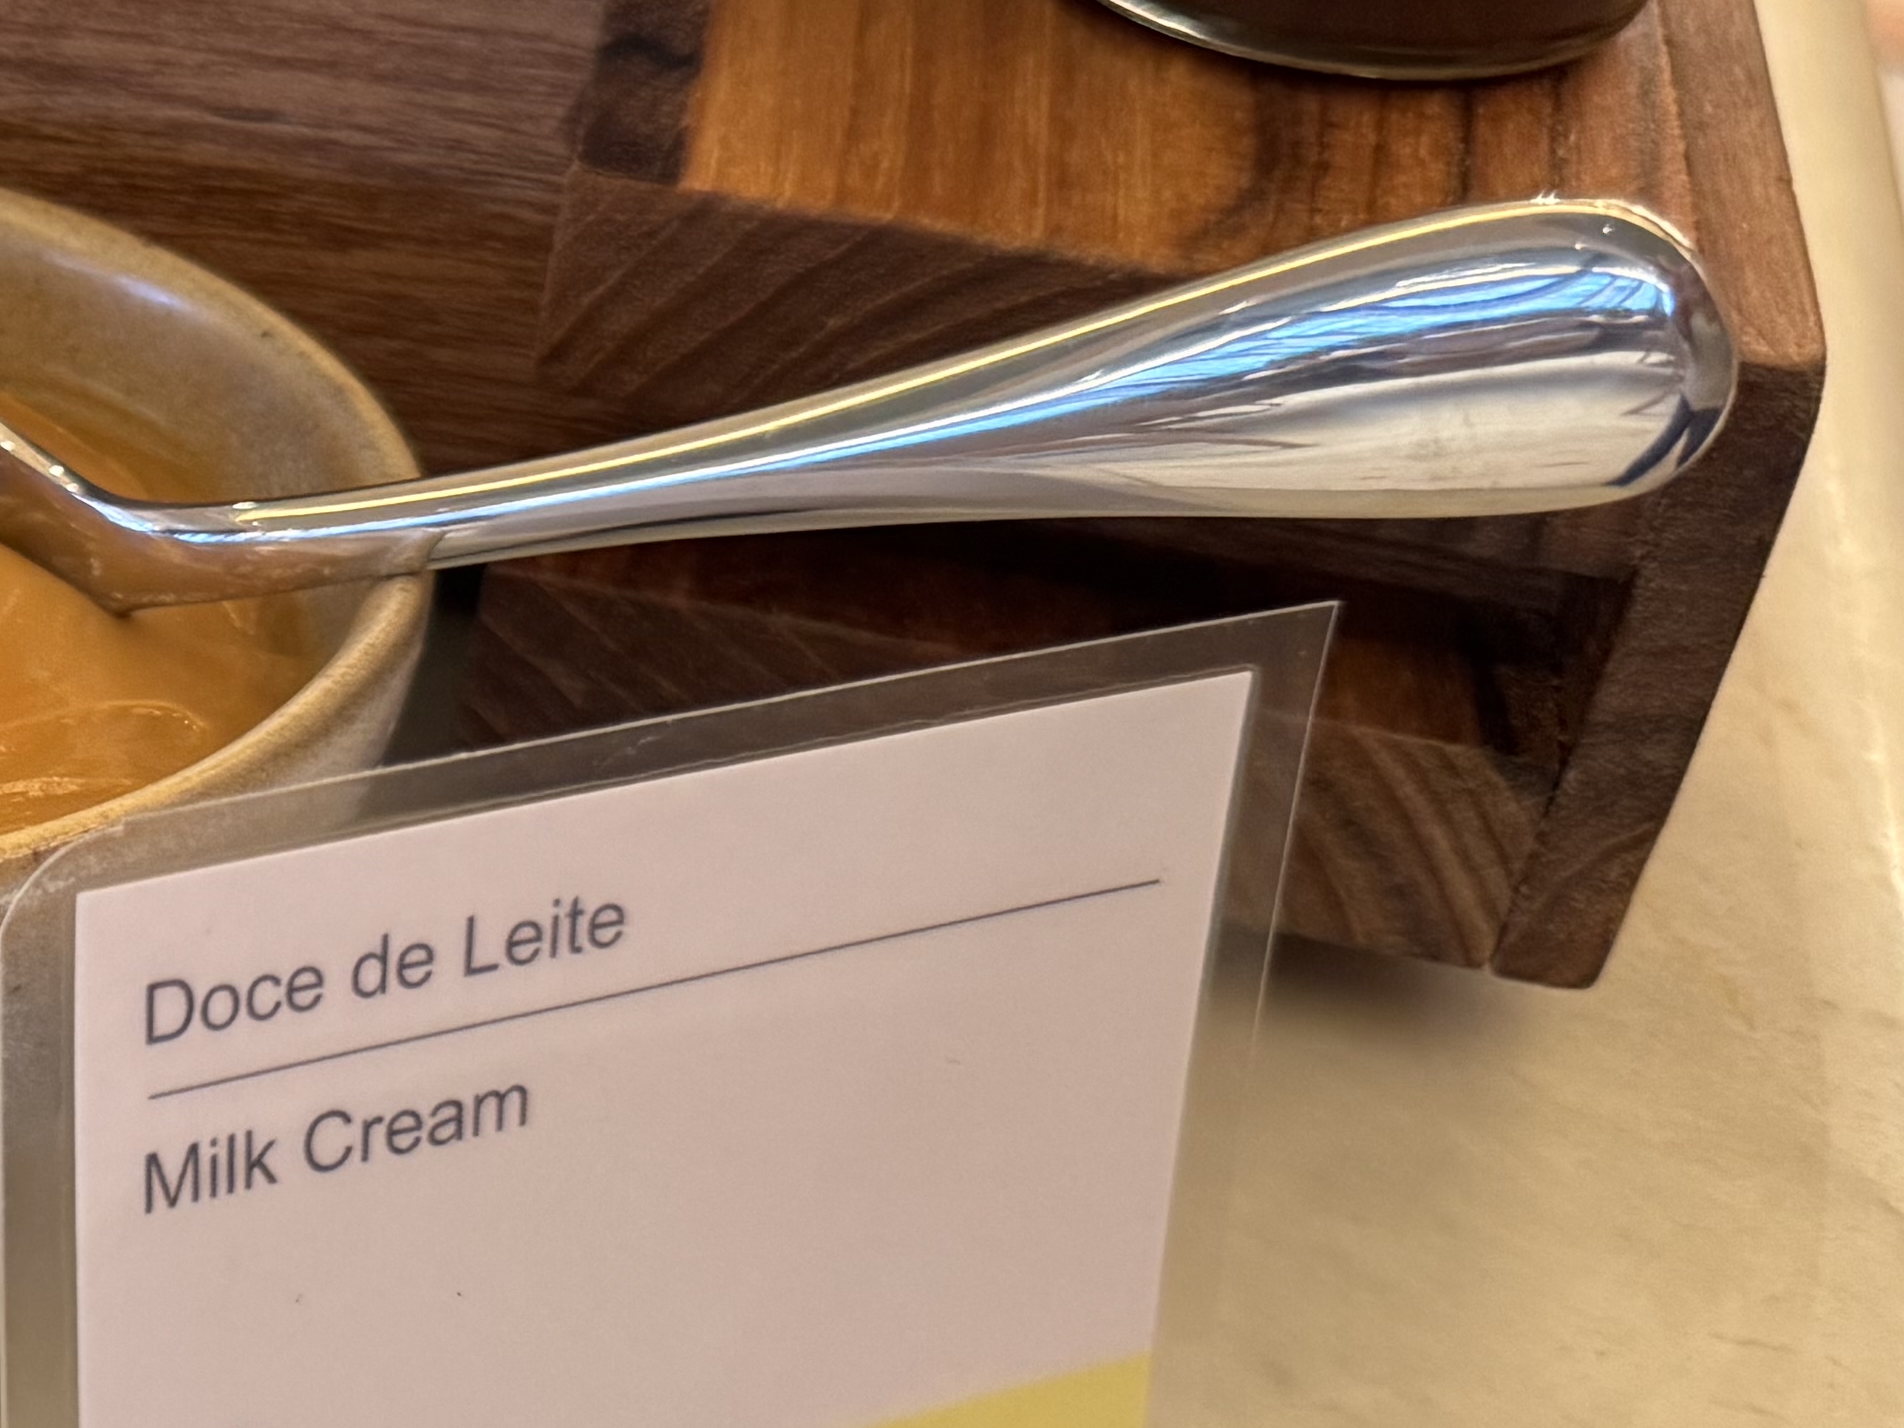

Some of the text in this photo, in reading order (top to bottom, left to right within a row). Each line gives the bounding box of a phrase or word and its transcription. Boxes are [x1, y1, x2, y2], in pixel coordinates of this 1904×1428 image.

[145, 895, 626, 1046] Doce de Leite
[144, 1083, 529, 1215] Milk Cream
